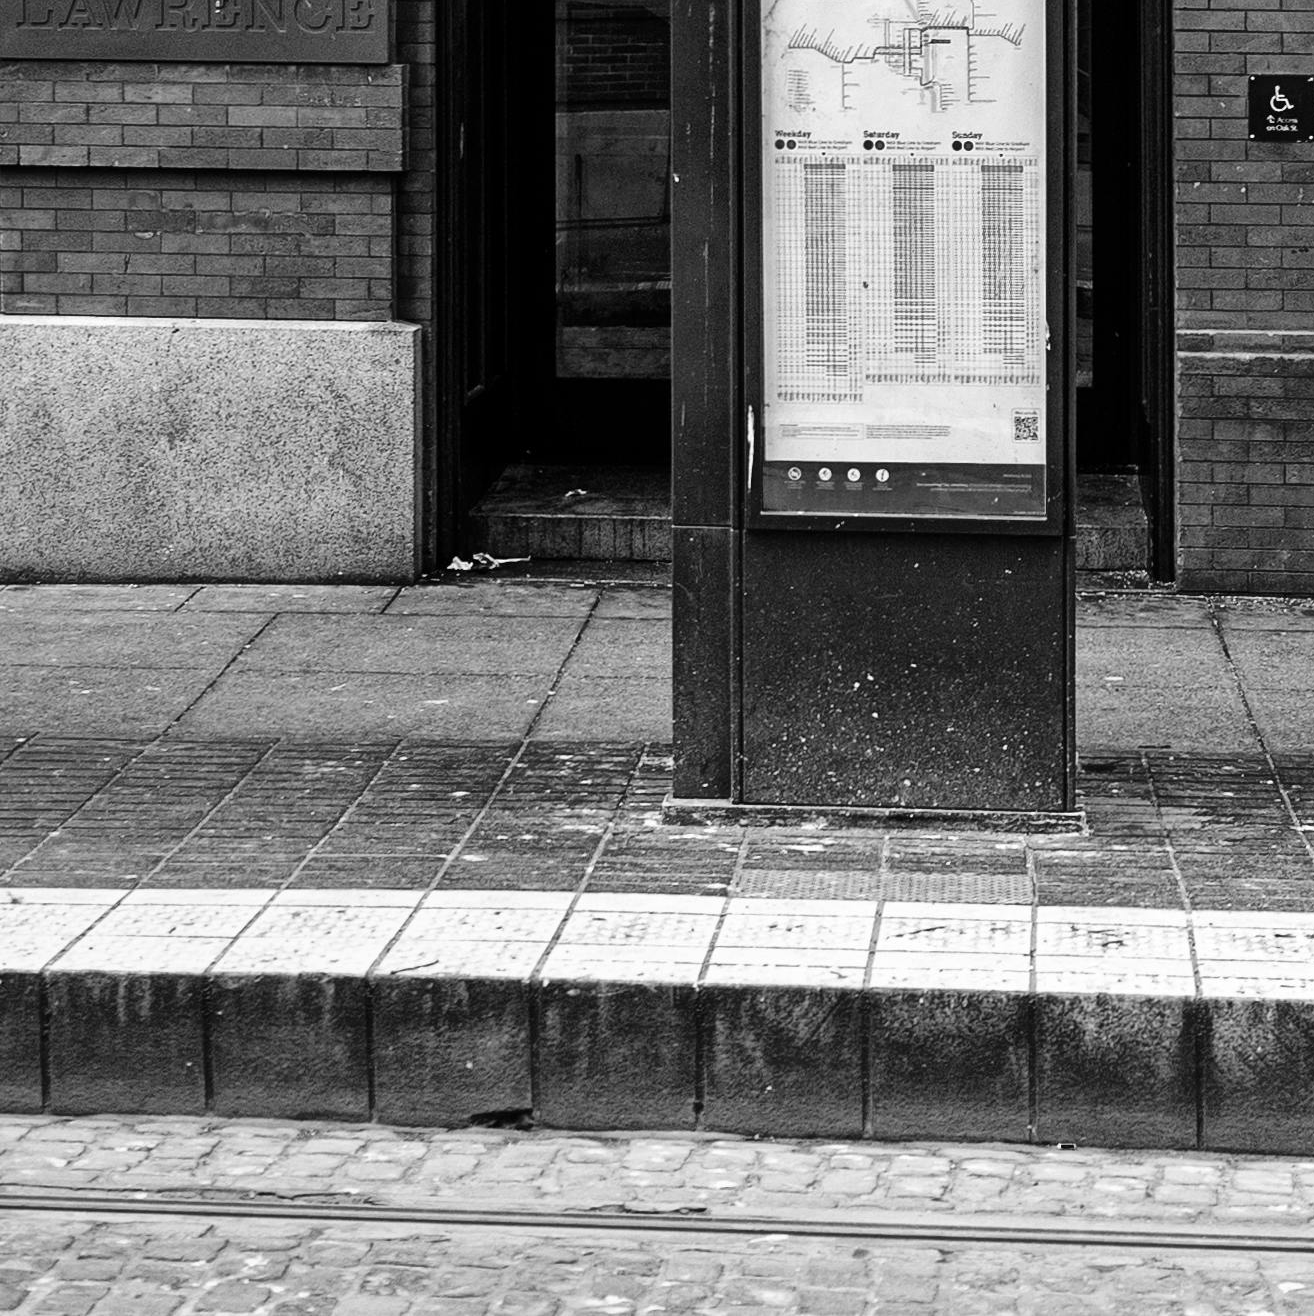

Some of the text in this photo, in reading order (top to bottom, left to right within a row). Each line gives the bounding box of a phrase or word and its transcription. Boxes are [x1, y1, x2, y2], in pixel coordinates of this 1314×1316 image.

[774, 130, 812, 139] Weekday
[863, 130, 900, 140] Saturday
[952, 130, 983, 140] Sunday
